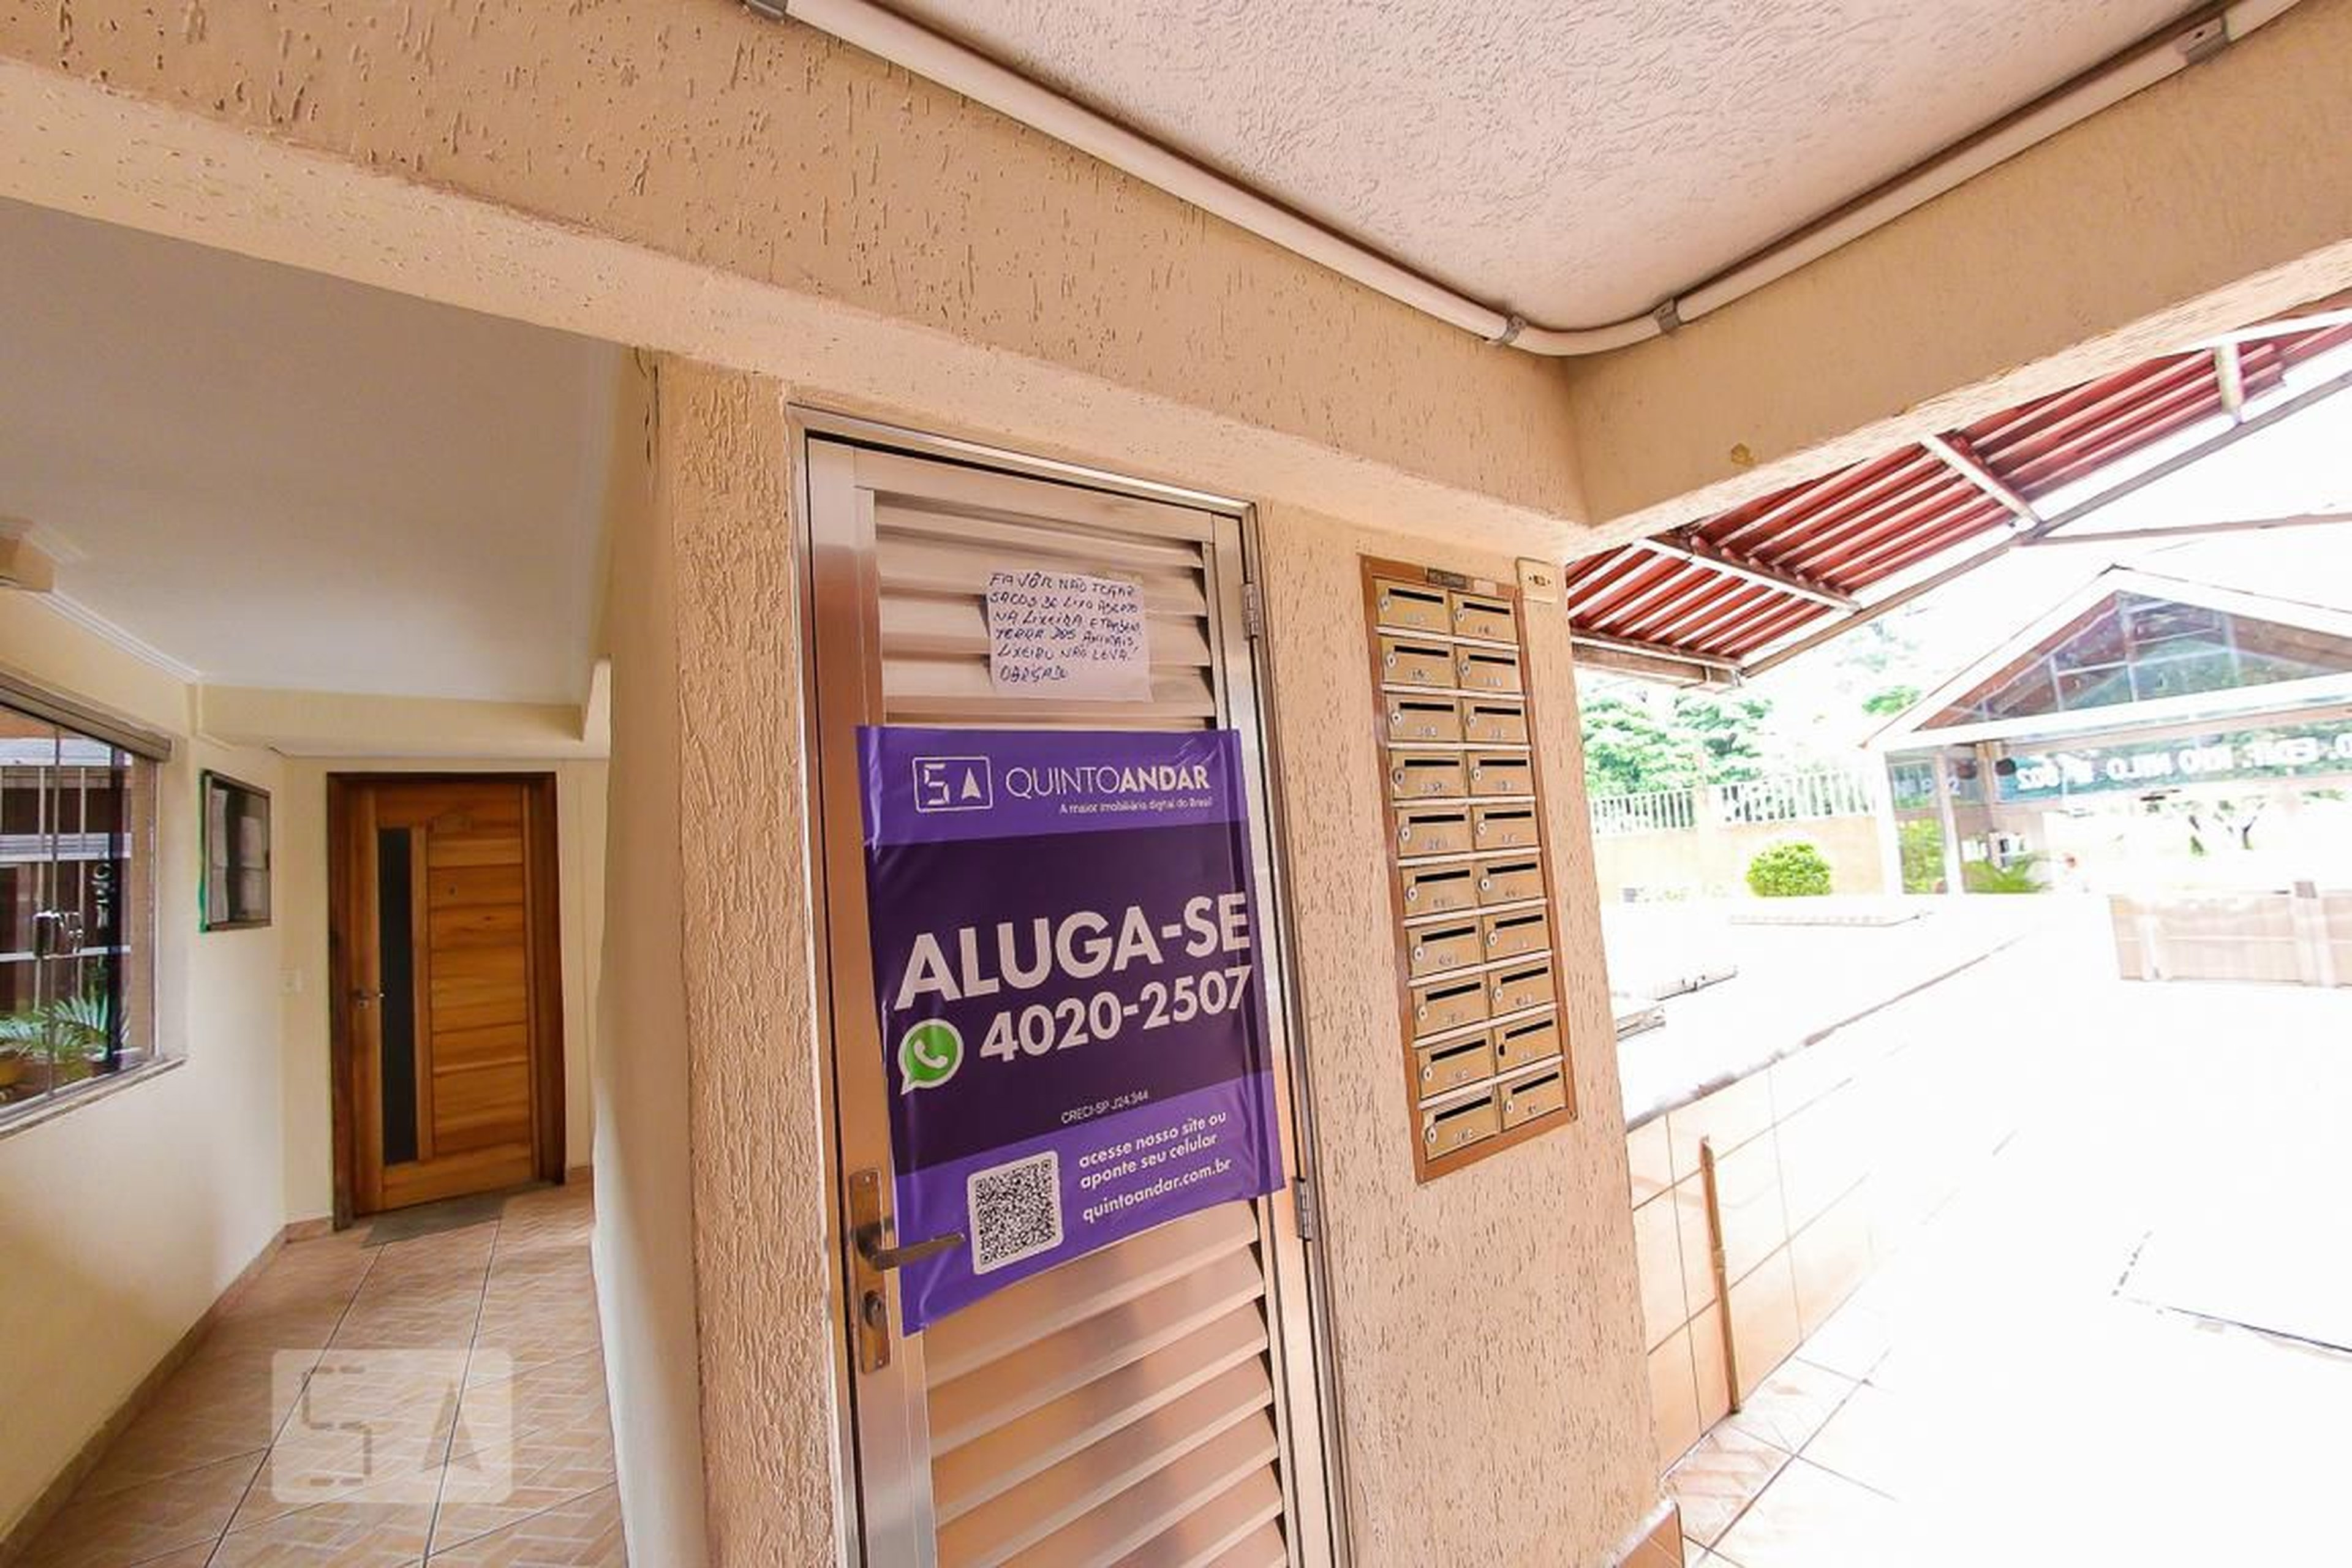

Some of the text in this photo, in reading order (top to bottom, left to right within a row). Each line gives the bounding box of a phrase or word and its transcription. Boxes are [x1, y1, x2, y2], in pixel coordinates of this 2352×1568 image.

[989, 591, 1038, 608] SACOS
[1058, 577, 1087, 593] NÃO
[993, 612, 1017, 626] NA
[1005, 764, 1210, 799] QUINTOANDAR
[1060, 803, 1068, 813] A
[1069, 804, 1097, 813] maior
[1149, 798, 1175, 812] digital
[1176, 798, 1188, 808] do
[1189, 796, 1212, 808] Brasil
[894, 891, 1251, 1011] ALUGA-SE
[980, 965, 1252, 1063] 4020-2507
[1079, 1112, 1226, 1169] acesse nosso site ou
[1080, 1133, 1217, 1189] aponte seu celular
[1082, 1158, 1232, 1224] quintoandar.com.br
